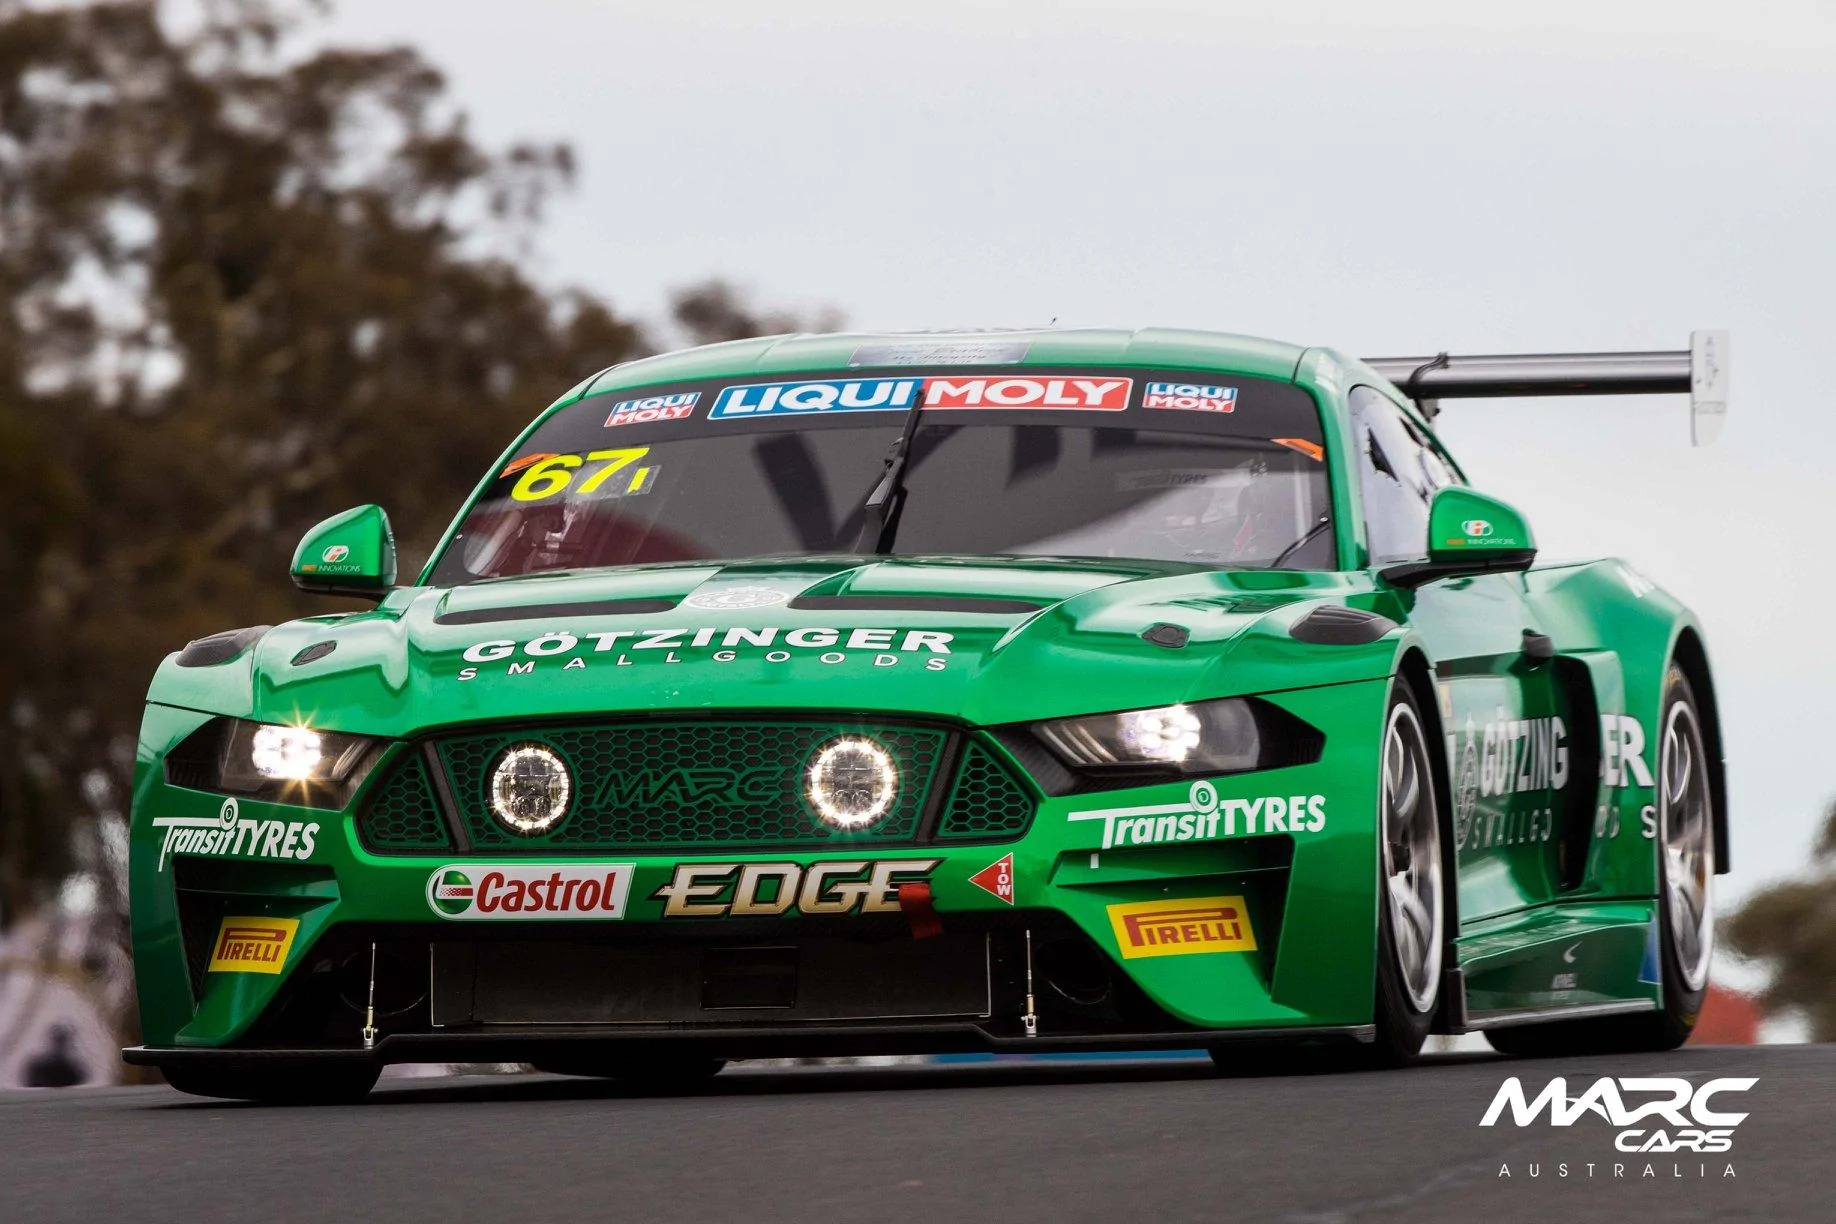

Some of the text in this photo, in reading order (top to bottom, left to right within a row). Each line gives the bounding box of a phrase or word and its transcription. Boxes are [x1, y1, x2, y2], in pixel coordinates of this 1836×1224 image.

[616, 394, 698, 413] LIQUI
[721, 379, 1125, 415] LIQUI MOLY
[1148, 396, 1232, 411] MOLY
[1151, 384, 1232, 399] LIQUI
[610, 405, 692, 424] MOLY
[462, 627, 955, 663] GÖTZINGER
[457, 650, 947, 681] SMALLGOODS
[597, 767, 785, 806] MARC
[476, 871, 616, 912] Castrol
[655, 860, 938, 917] EDGE
[996, 862, 1011, 896] TOW
[1122, 907, 1242, 946] PIRELLI
[216, 927, 287, 962] PIRELLI
